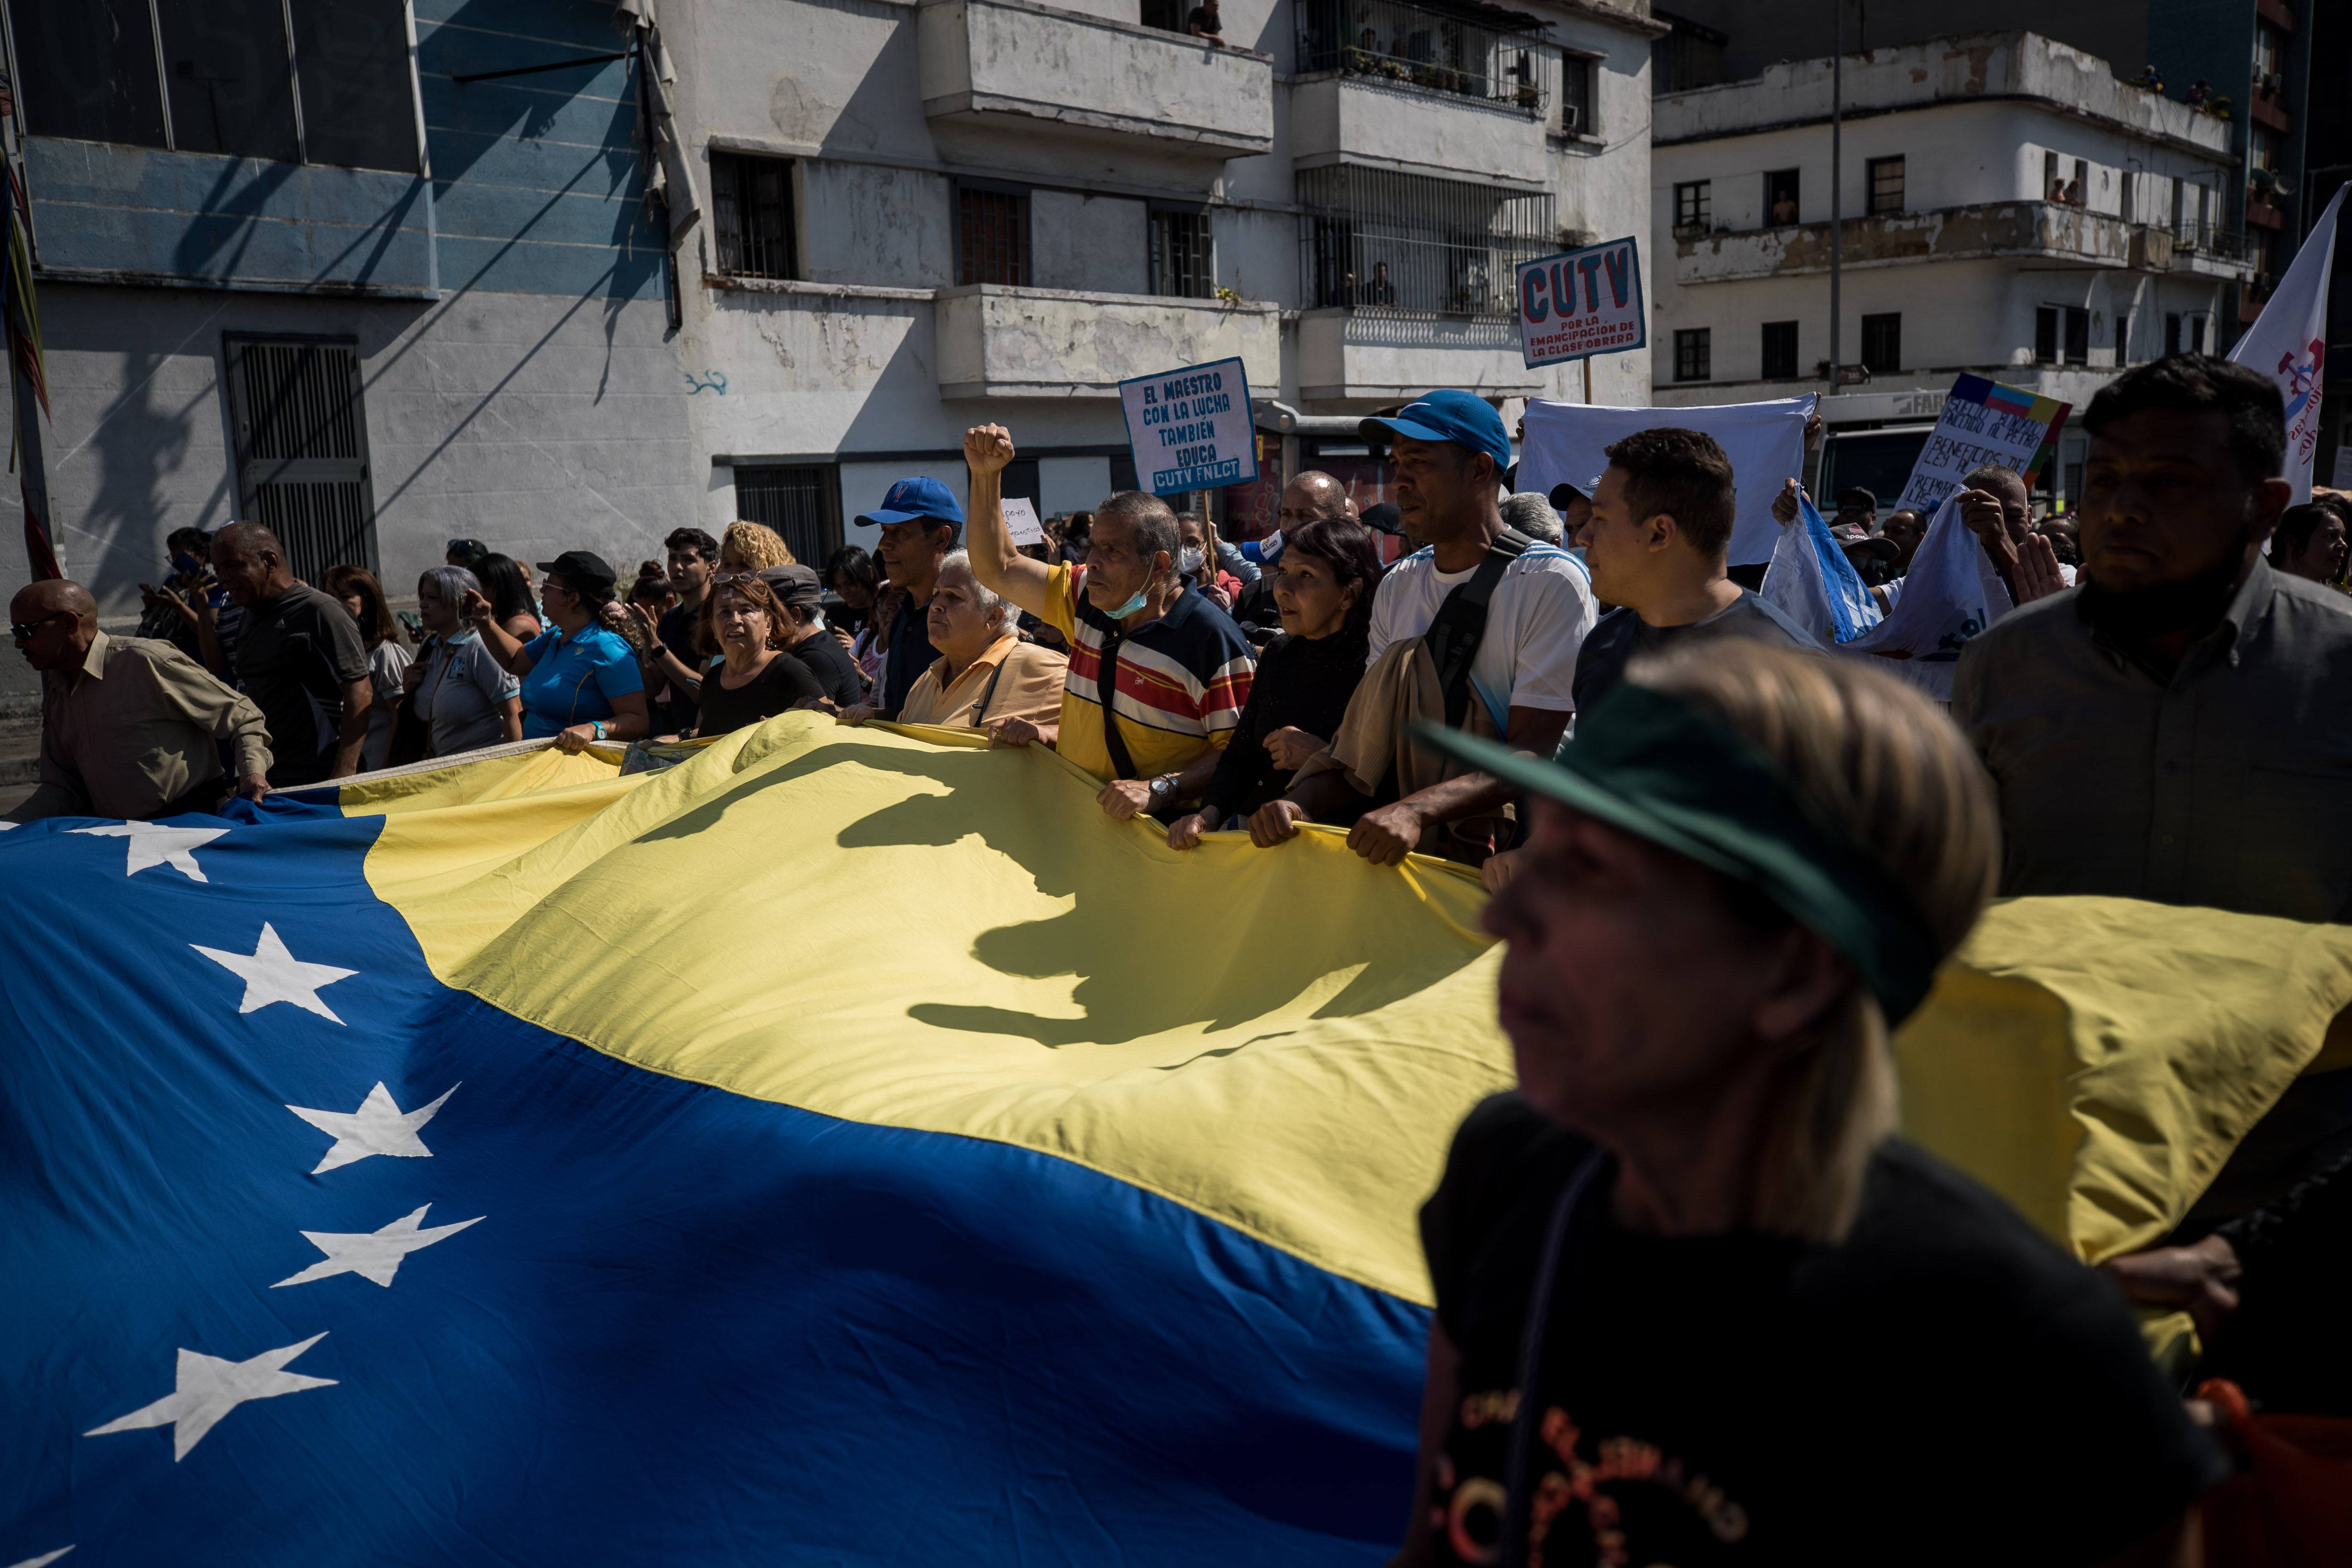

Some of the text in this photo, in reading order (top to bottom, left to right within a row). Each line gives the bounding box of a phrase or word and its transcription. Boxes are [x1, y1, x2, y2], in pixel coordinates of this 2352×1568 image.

[1523, 247, 1628, 323] CUTV
[1530, 320, 1635, 346] EMANCIPACIÓN DE
[1561, 316, 1599, 331] POR LA
[1533, 332, 1634, 358] LA CLASE OBRERA
[1144, 372, 1222, 405] EL MAESTRO
[1143, 393, 1231, 426] CON LA LUCHA
[1914, 394, 1943, 414] FAR
[1158, 416, 1215, 447] TAMBIÉN
[2004, 428, 2040, 449] PETRO
[1176, 444, 1217, 468] EDUCA
[2007, 455, 2025, 472] DE
[1155, 461, 1237, 487] CUTV FNLCT
[1907, 488, 1930, 505] LAS
[1003, 509, 1025, 520] poyo
